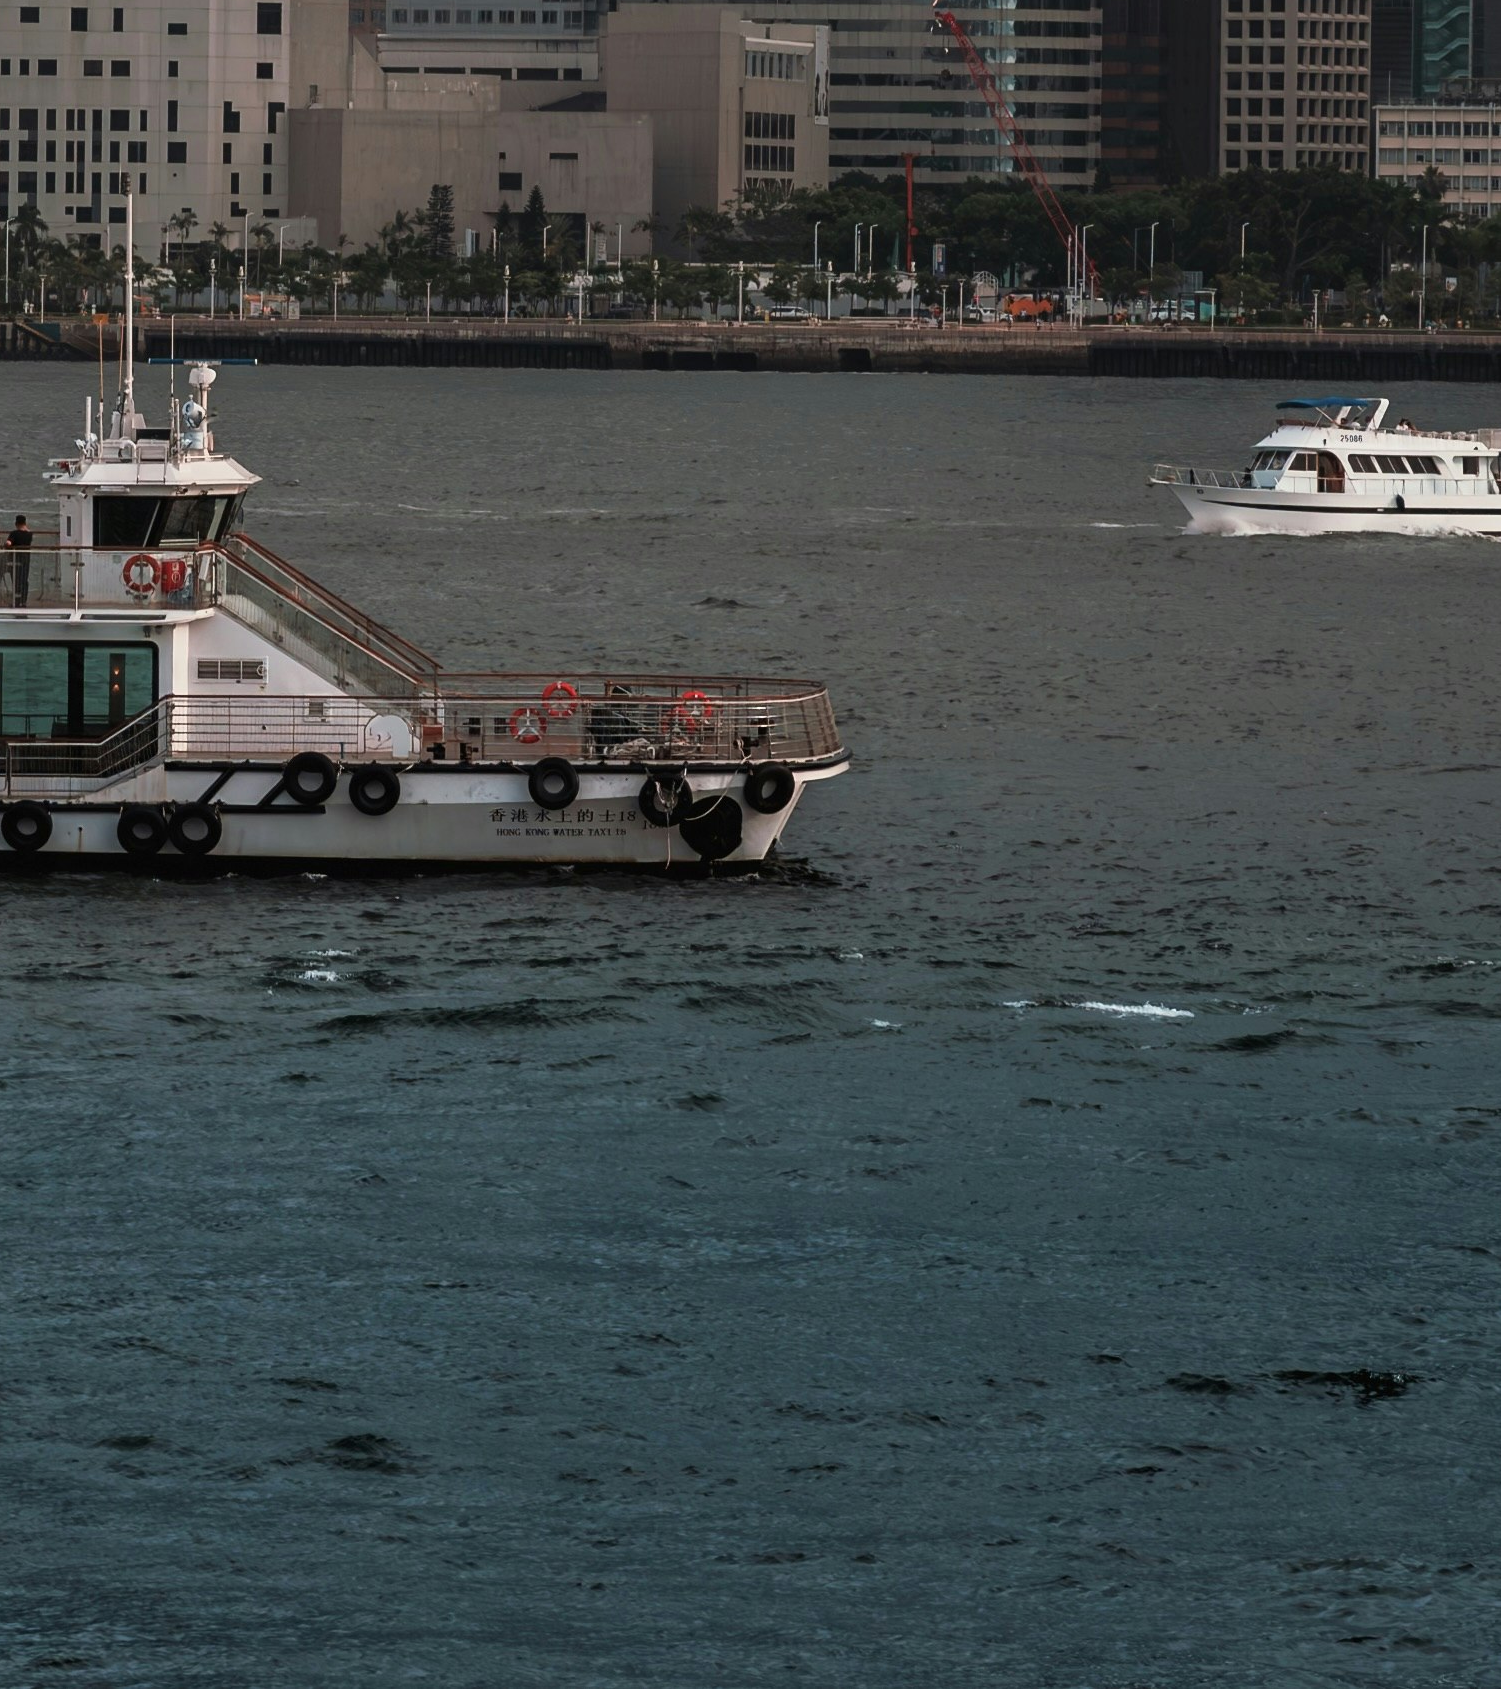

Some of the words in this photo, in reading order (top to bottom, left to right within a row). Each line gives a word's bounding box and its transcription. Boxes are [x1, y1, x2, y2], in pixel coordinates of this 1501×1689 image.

[496, 828, 521, 836] HONG
[525, 828, 550, 836] KONG
[553, 828, 584, 836] WATER
[588, 828, 611, 836] TAXI
